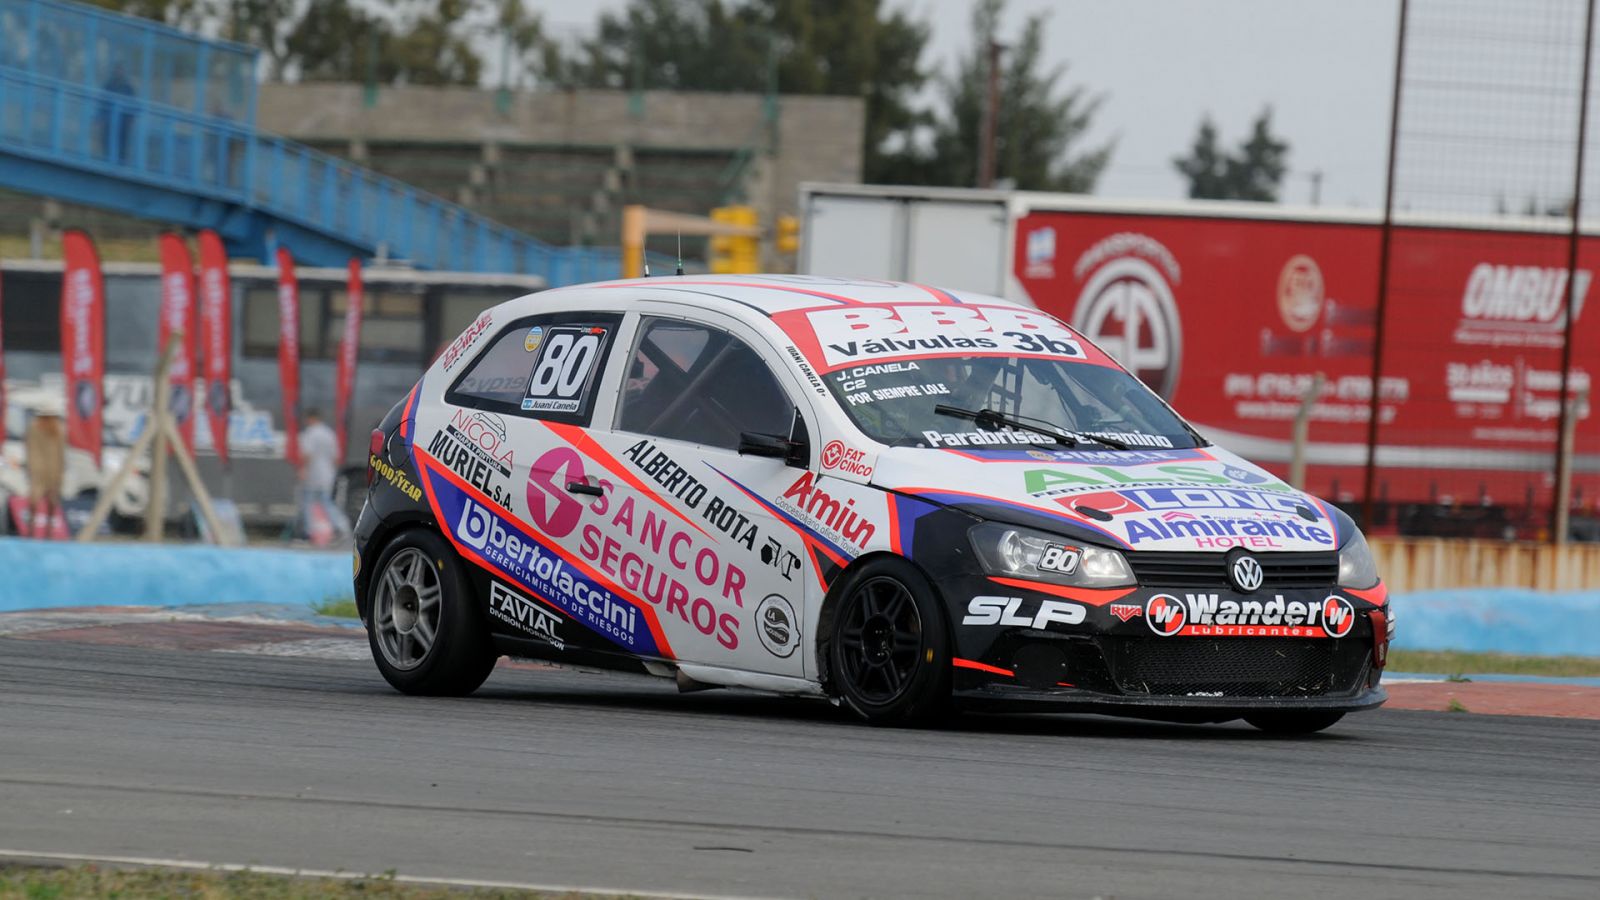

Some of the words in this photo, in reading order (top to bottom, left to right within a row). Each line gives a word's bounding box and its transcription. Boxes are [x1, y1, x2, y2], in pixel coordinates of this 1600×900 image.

[806, 305, 1073, 340] BBB
[828, 333, 999, 357] Válvulas
[1002, 331, 1078, 356] 3b
[530, 334, 598, 397] 80
[798, 363, 822, 388] CANELA
[836, 371, 850, 381] J.
[853, 361, 920, 378] CANELA
[843, 379, 867, 392] C2
[846, 391, 874, 406] POR
[872, 384, 922, 401] SIEMPRE
[920, 383, 950, 395] LOLE
[531, 399, 553, 409] Juani
[553, 400, 577, 410] Canela
[451, 409, 514, 470] NICOLA
[922, 427, 1057, 448] Parabrisas
[476, 448, 502, 471] PINTURA
[844, 448, 866, 461] FAT
[428, 429, 493, 498] MURIEL
[493, 485, 513, 513] S.A.
[839, 460, 872, 477] CINCO
[1024, 466, 1231, 494] ALS
[622, 439, 708, 509] ALBERTO
[702, 496, 759, 551] ROTA
[1123, 514, 1333, 545] Almirante
[1195, 536, 1283, 548] HOTEL
[589, 478, 746, 609] SANCOR
[1041, 547, 1078, 572] 80
[489, 513, 636, 634] bertolaccini
[485, 546, 568, 606] GERENCIAMIENTO
[570, 602, 584, 617] DE
[588, 611, 635, 646] RIESGOS
[579, 523, 740, 651] SEGUROS
[489, 607, 522, 630] DIVISION
[962, 596, 1087, 630] SLP
[1110, 604, 1142, 622] RIVA
[1185, 594, 1322, 626] Wander
[1191, 626, 1313, 636] Lubricantes
